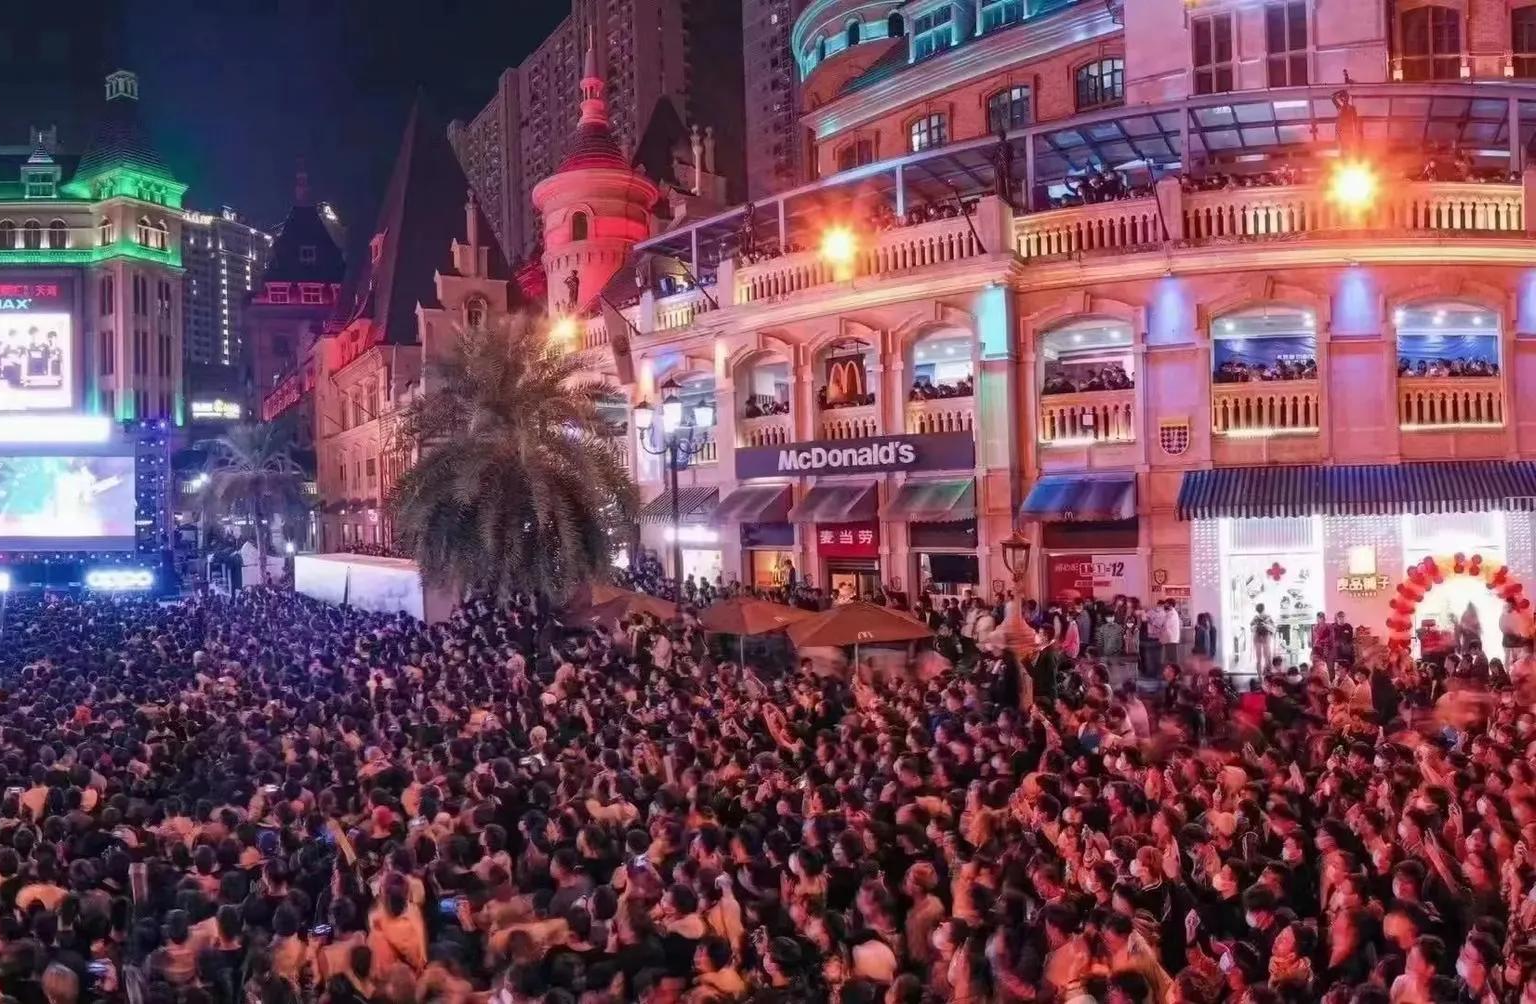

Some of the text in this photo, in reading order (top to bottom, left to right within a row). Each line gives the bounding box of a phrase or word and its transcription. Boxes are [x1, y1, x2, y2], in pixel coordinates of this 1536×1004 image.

[778, 441, 915, 471] McDonald's
[820, 529, 872, 545] 麦当劳
